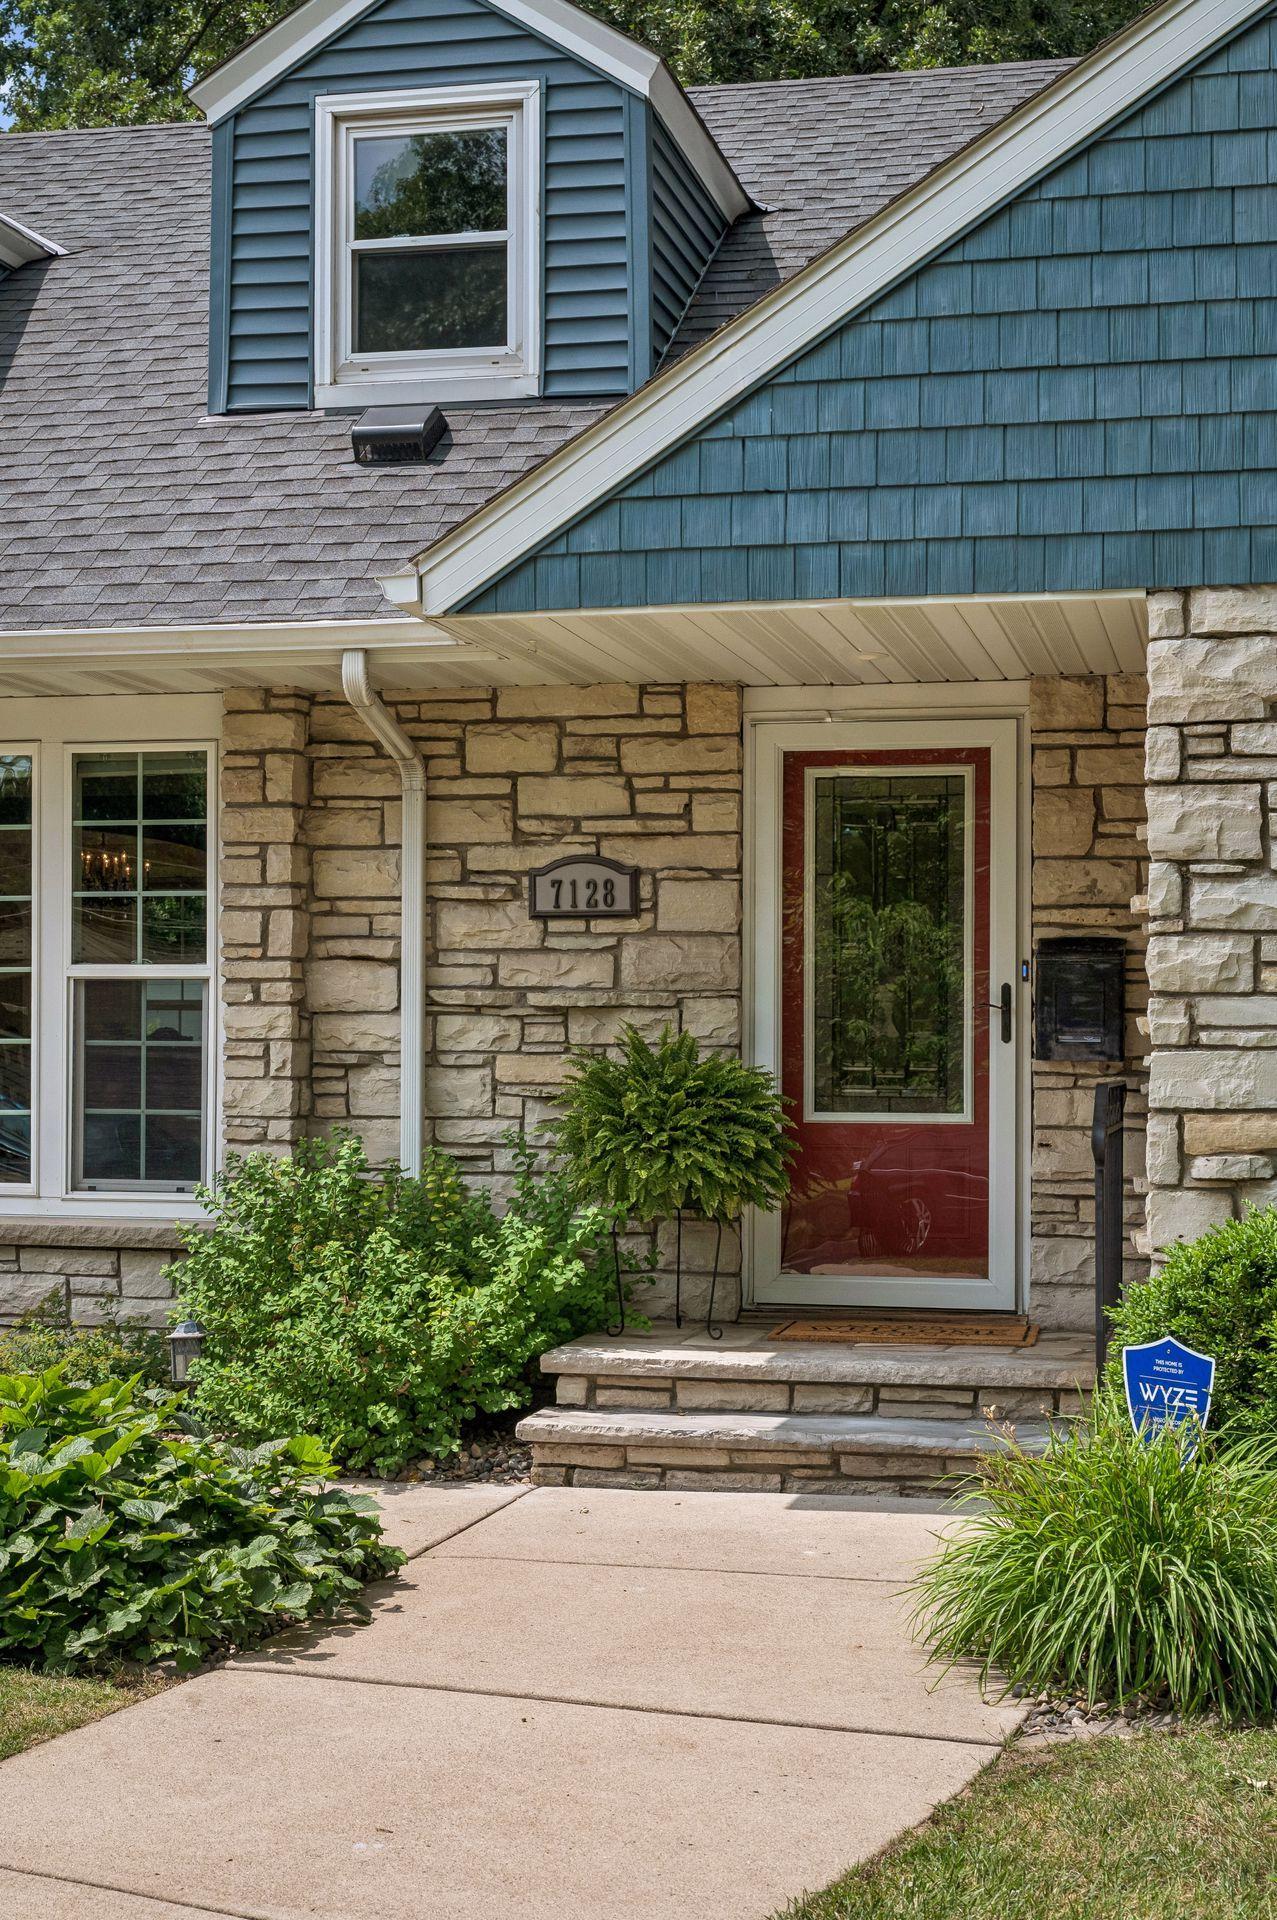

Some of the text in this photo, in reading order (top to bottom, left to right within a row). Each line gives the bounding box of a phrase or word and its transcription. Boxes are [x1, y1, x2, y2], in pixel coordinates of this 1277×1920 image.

[550, 878, 615, 909] 7128
[1153, 1366, 1178, 1374] PROTECTED
[1139, 1382, 1198, 1409] WYZE
